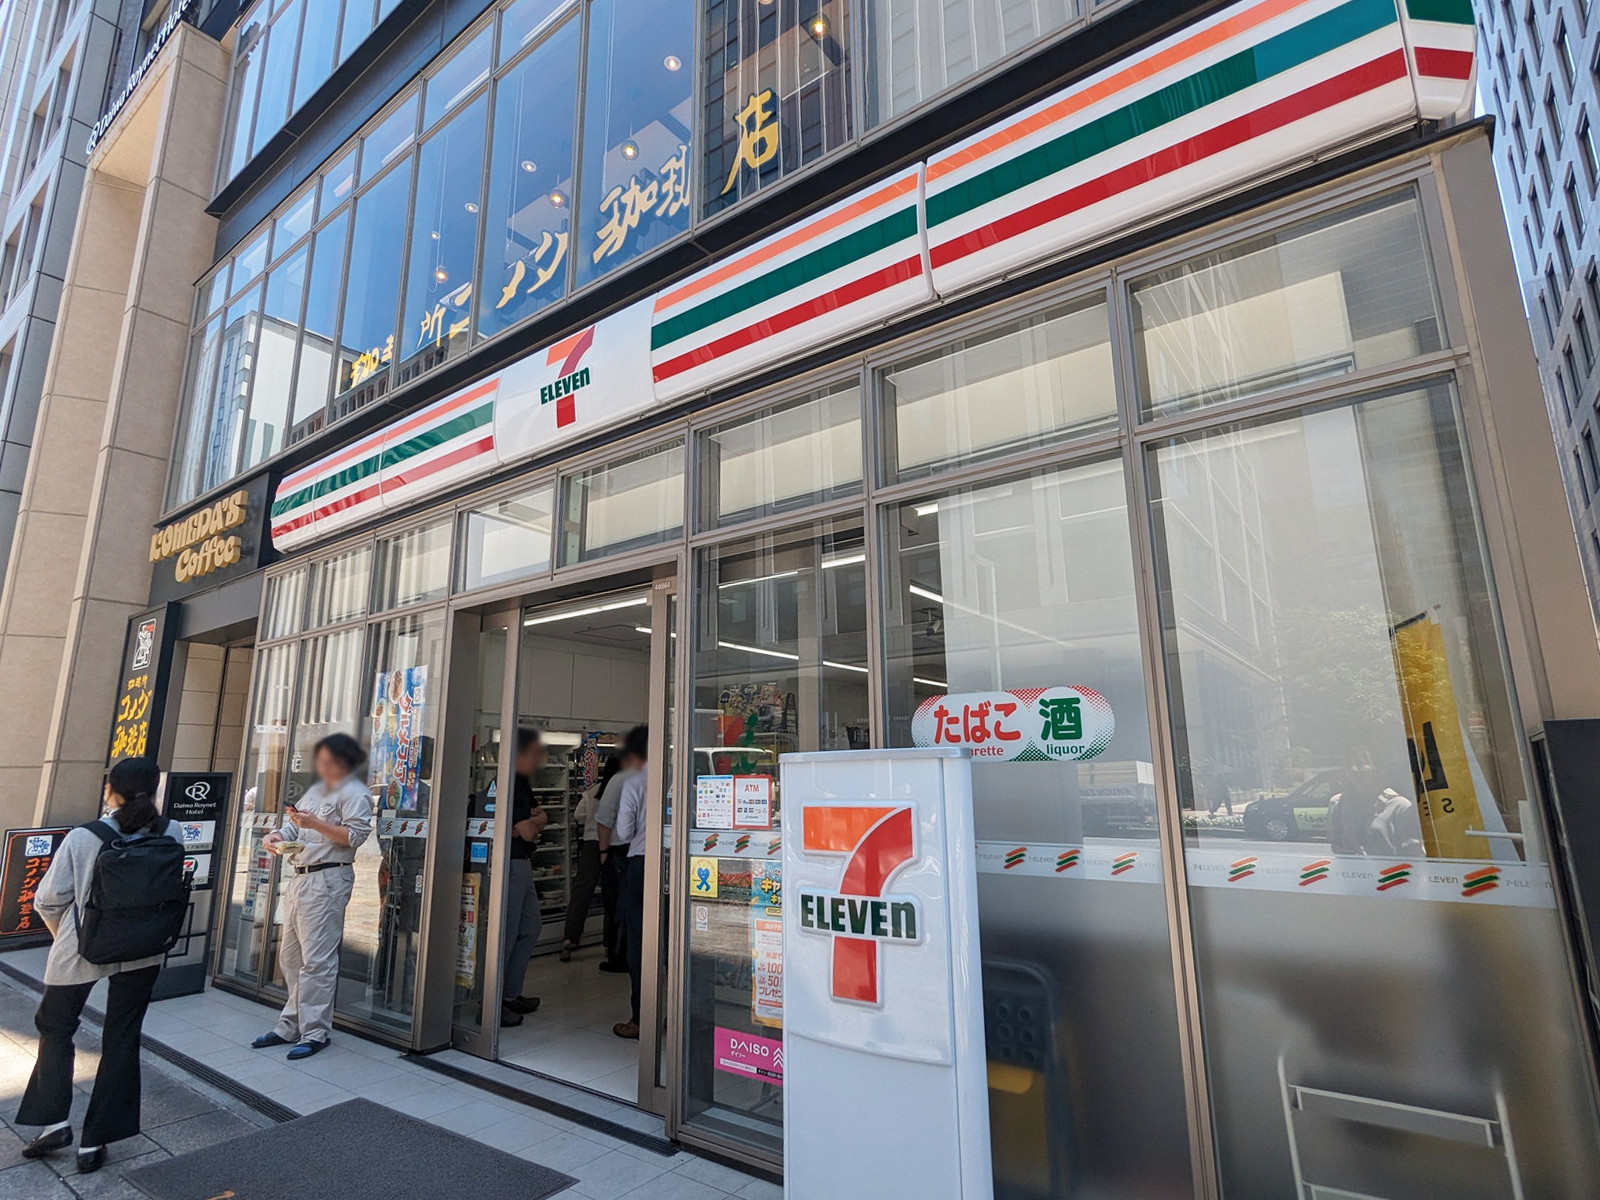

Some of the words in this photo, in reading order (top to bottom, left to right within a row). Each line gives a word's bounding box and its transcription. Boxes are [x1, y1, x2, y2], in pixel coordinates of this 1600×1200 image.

[175, 535, 242, 583] Coffee
[933, 699, 1022, 745] たばこ
[1038, 696, 1083, 741] 酒
[1046, 743, 1085, 756] liquor
[744, 784, 760, 793] ATM
[194, 801, 217, 811] Roynet
[802, 806, 914, 1004] 7
[730, 1037, 770, 1057] DAISO
